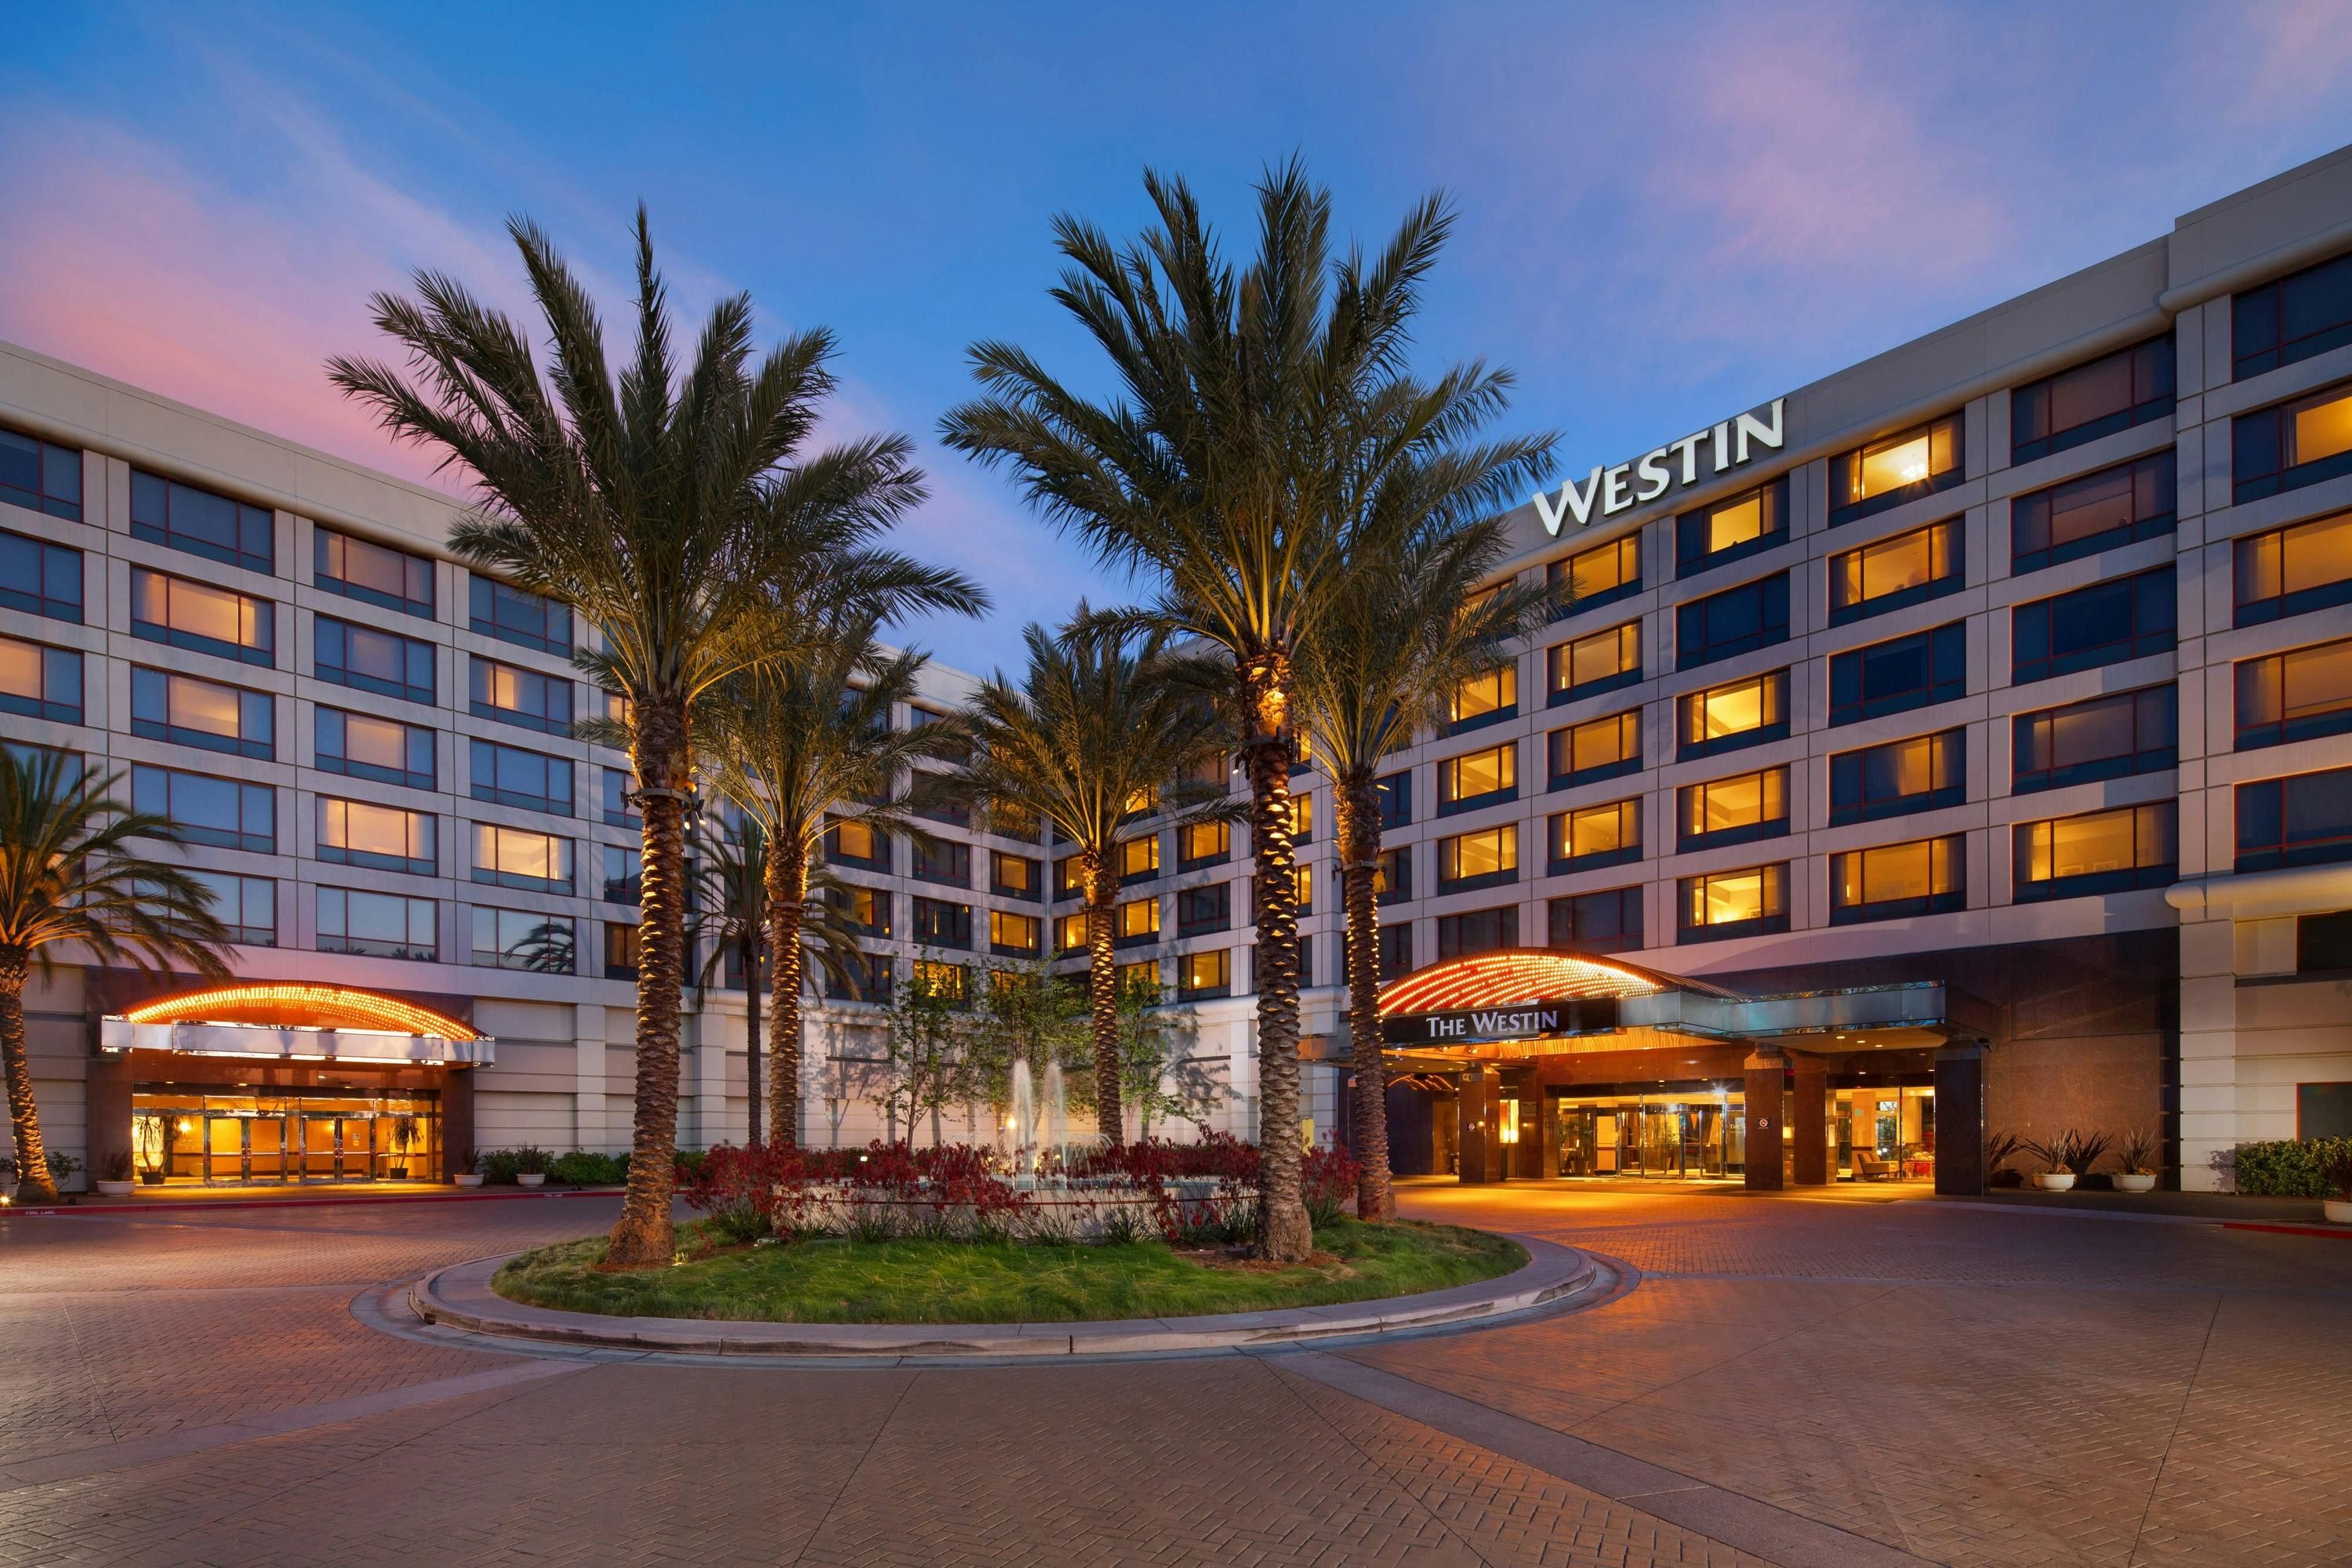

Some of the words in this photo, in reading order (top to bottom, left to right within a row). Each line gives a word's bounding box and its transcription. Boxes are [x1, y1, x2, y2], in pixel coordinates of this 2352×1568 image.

[1532, 397, 1787, 537] WESTIN
[1425, 1016, 1466, 1037] THE
[1471, 1010, 1558, 1033] WESTIN
